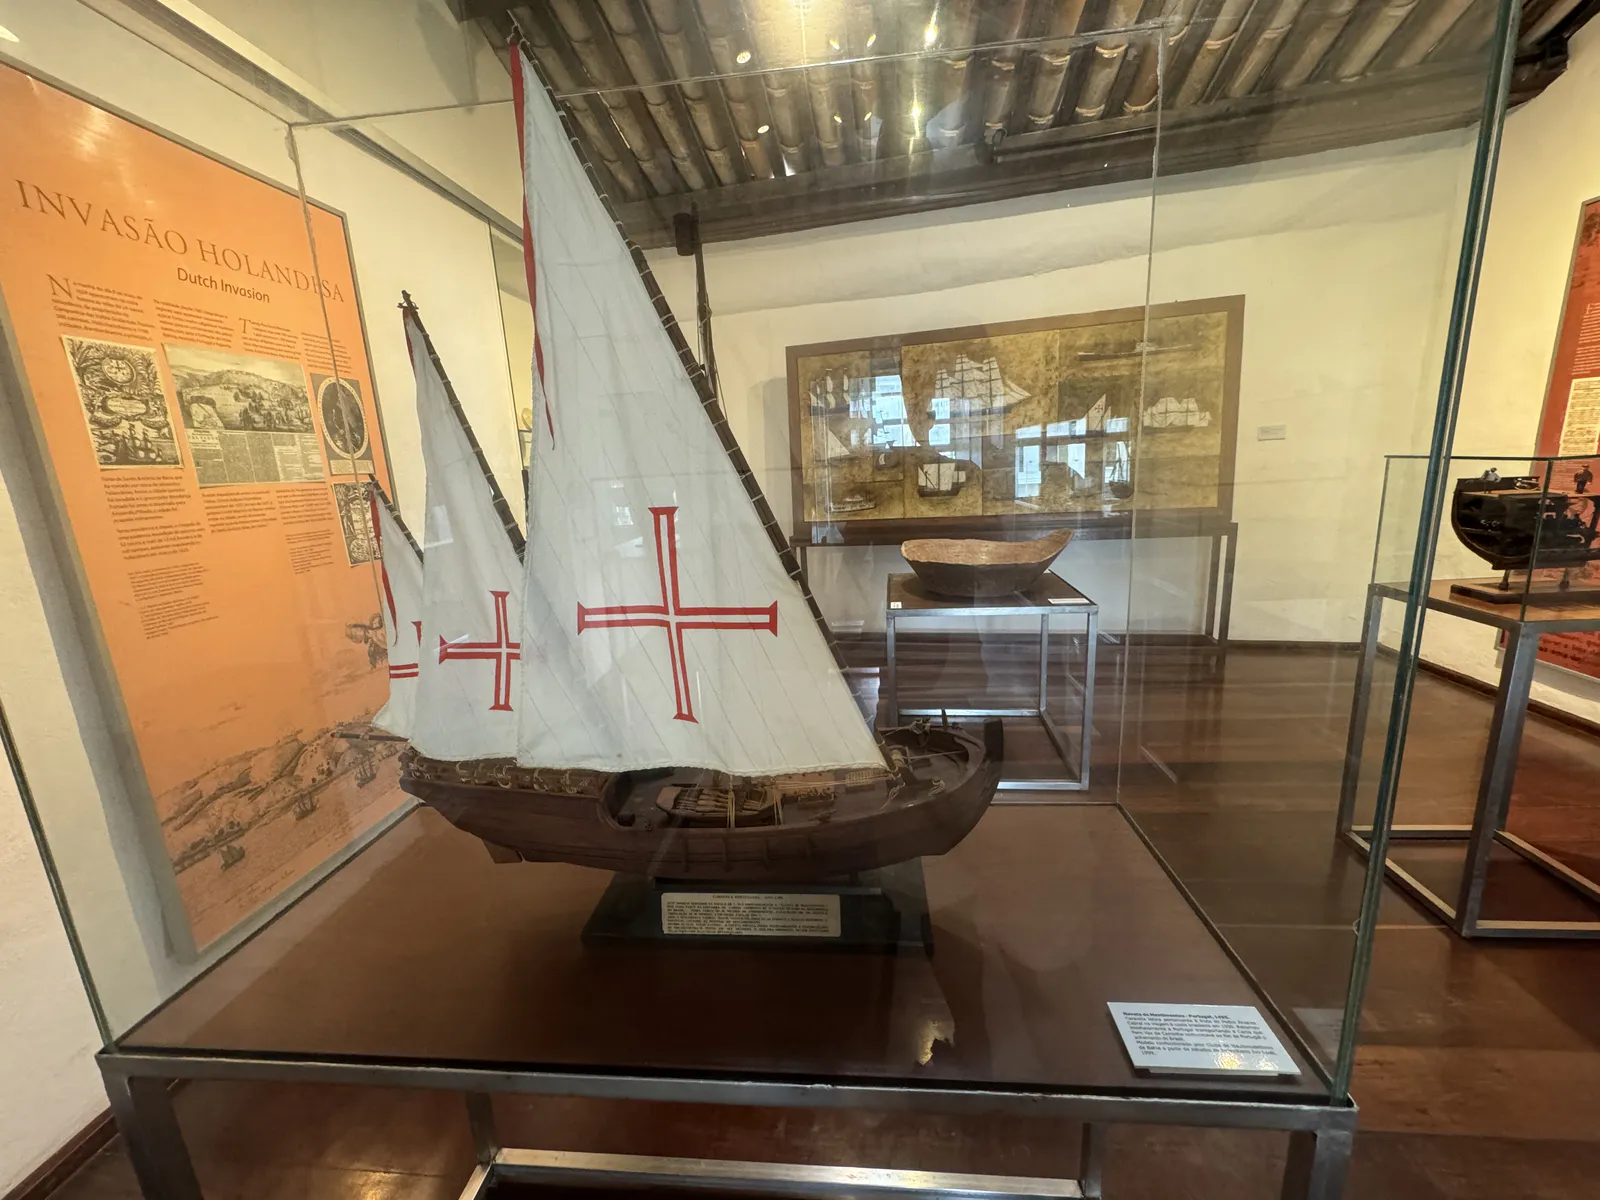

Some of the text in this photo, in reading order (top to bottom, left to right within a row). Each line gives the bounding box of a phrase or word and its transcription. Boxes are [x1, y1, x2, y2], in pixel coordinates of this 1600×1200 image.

[14, 178, 188, 255] INVASÃO
[177, 267, 271, 303] Dutch Invasion
